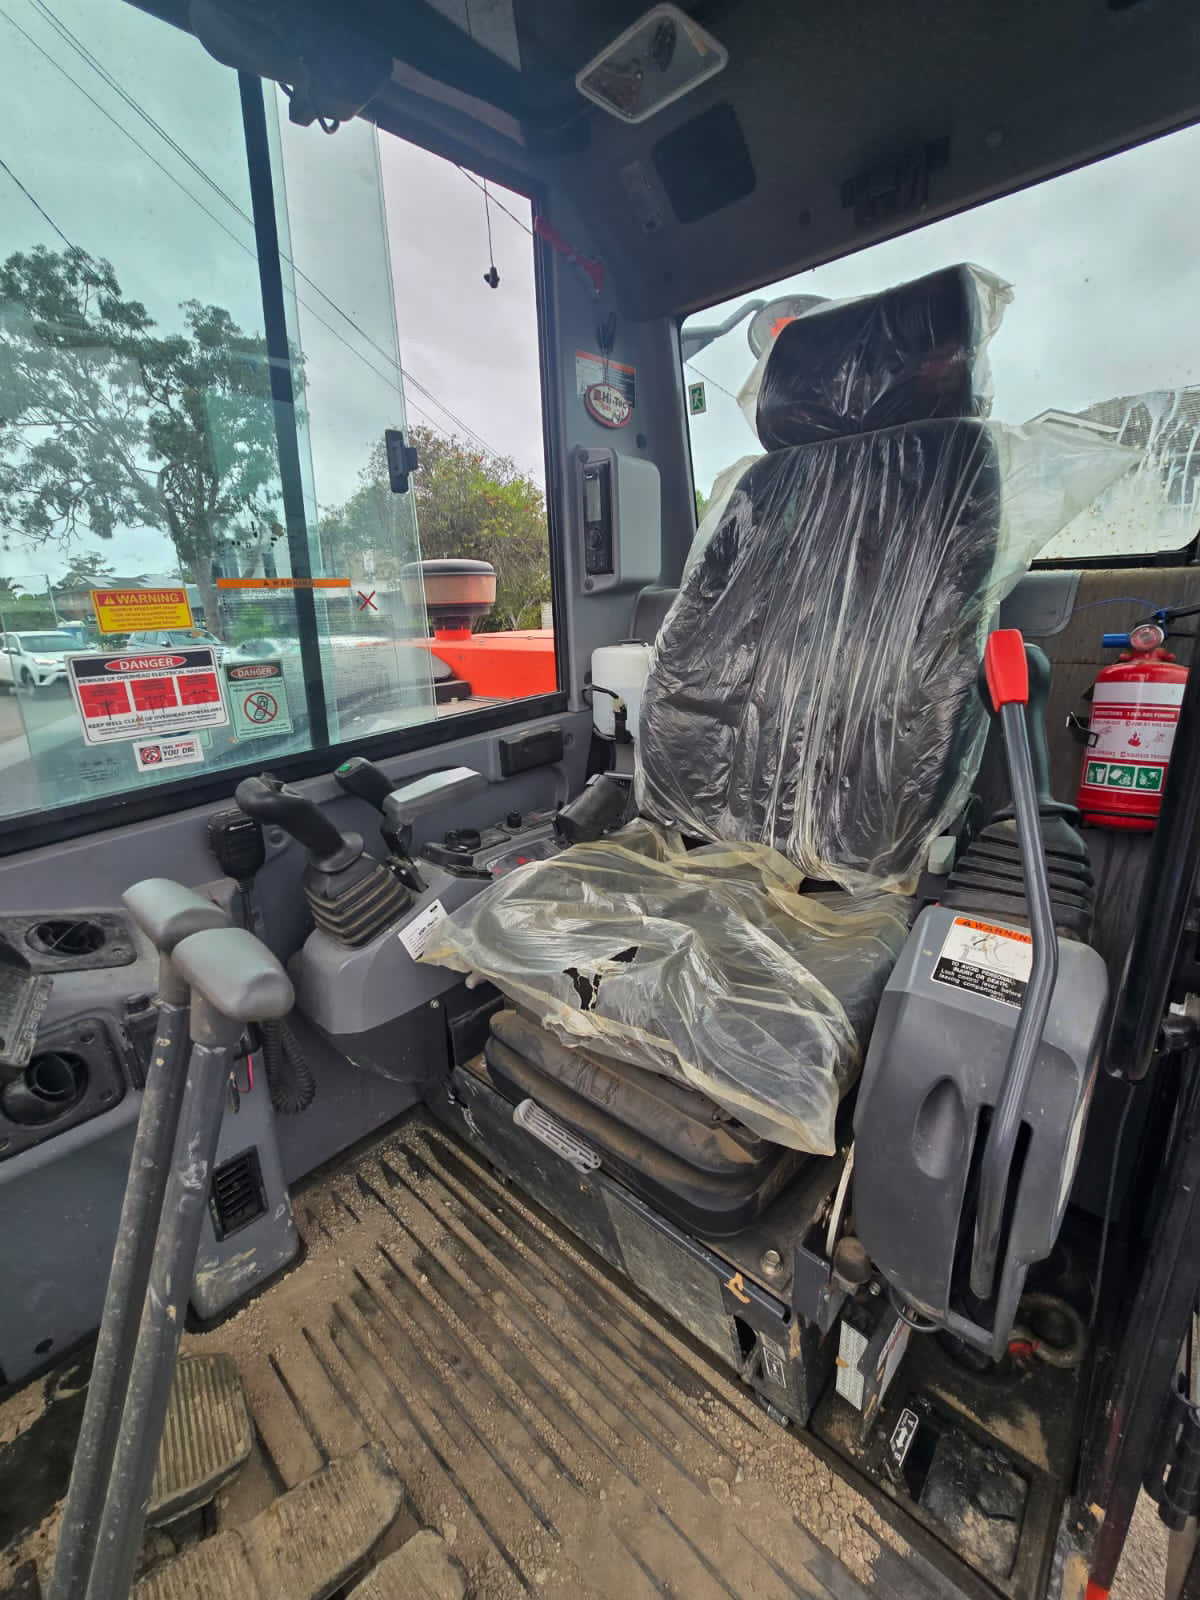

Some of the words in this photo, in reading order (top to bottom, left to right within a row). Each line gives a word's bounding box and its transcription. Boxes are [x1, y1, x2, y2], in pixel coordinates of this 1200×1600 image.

[116, 592, 180, 605] WARNING
[119, 657, 174, 671] DANGER
[117, 672, 151, 681] OVERHEAD
[152, 668, 184, 678] ELECTRICAL
[238, 667, 272, 677] DANGER
[105, 719, 122, 727] WELL
[153, 710, 187, 720] OVERHEAD
[187, 706, 222, 716] POWERLINES
[162, 748, 179, 757] YOU
[952, 966, 974, 976] INJURY
[960, 963, 980, 973] AVOID
[939, 972, 960, 984] leaving
[940, 967, 955, 977] Lock
[957, 973, 979, 984] control
[981, 981, 998, 989] lever
[1001, 987, 1022, 998] before
